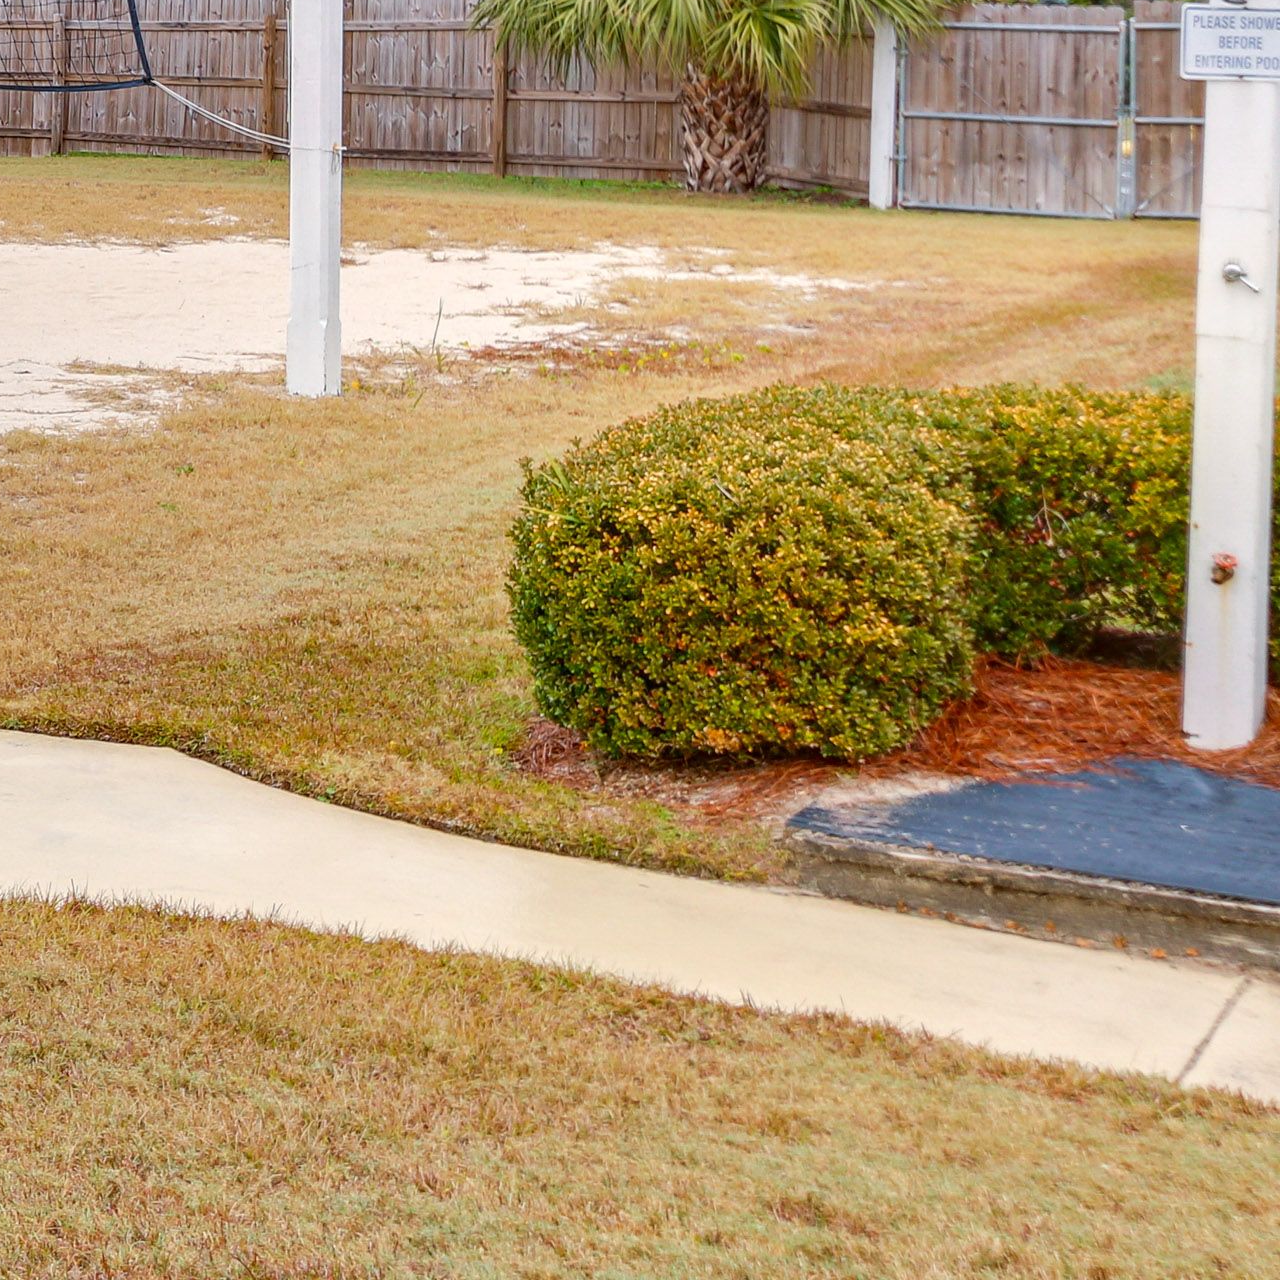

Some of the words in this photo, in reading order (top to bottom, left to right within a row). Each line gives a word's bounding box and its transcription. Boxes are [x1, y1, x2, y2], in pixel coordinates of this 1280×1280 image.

[1193, 15, 1236, 29] PLEASE
[1218, 36, 1263, 50] BEFORE
[1195, 55, 1252, 69] ENTERING
